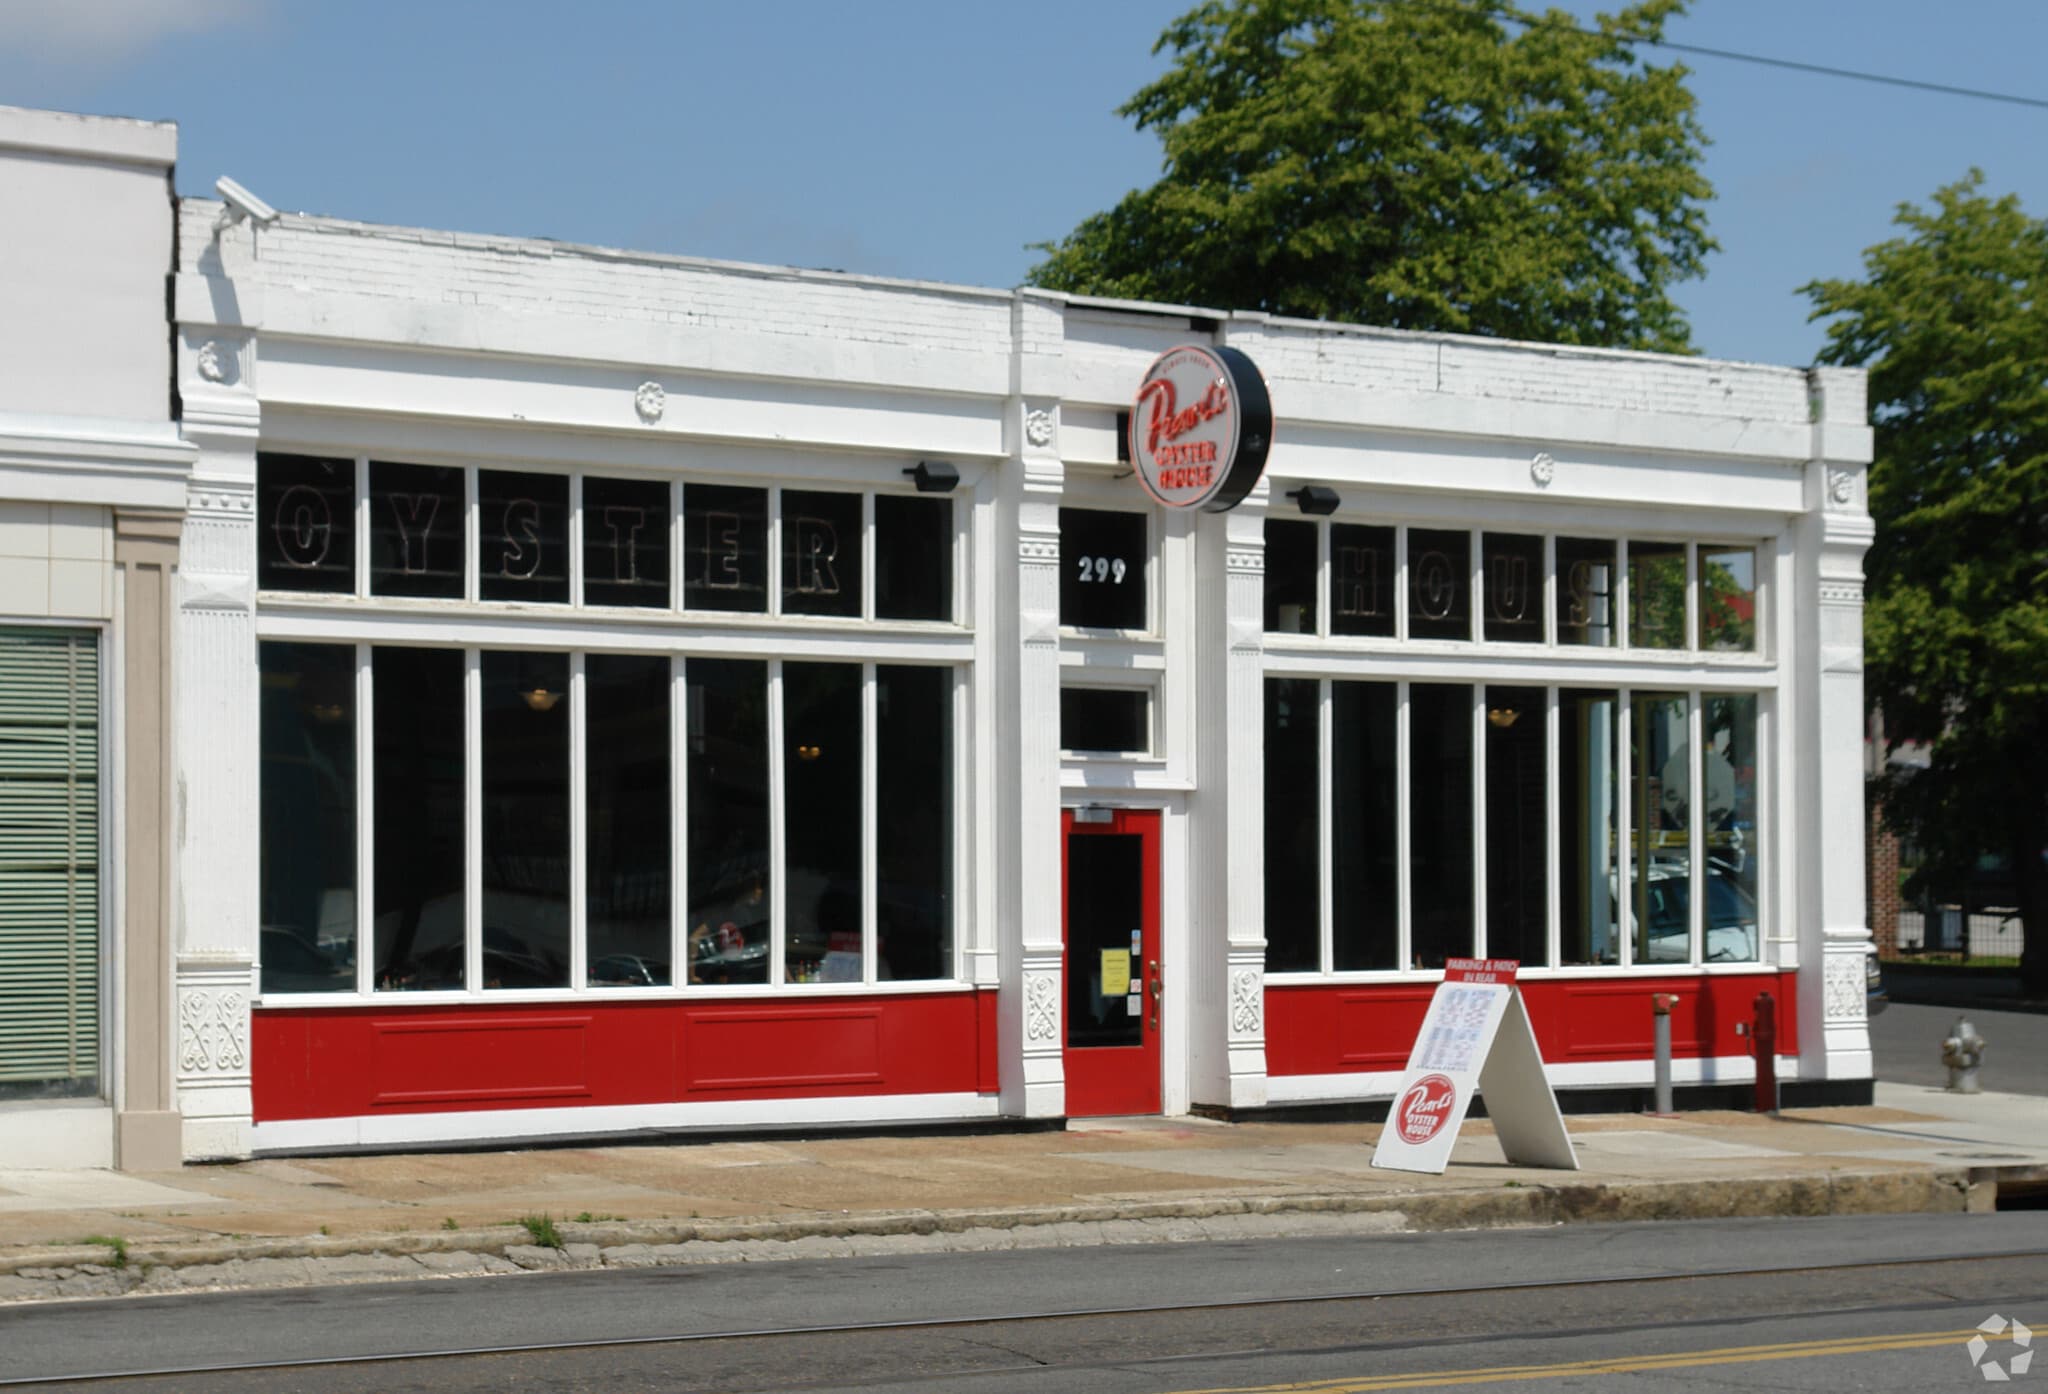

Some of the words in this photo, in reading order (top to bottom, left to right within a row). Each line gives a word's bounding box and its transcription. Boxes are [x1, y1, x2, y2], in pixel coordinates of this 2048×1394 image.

[1154, 441, 1217, 466] OYSTER
[1159, 465, 1213, 490] HOUSE
[276, 485, 839, 594] OYSTER
[1078, 556, 1126, 584] 299
[1448, 960, 1484, 970] PARKING
[1494, 961, 1517, 972] PATIO
[1463, 972, 1474, 982] IN
[1475, 972, 1497, 983] REAR
[1407, 1114, 1439, 1127] OYSTER
[1405, 1124, 1433, 1137] HOUSE
